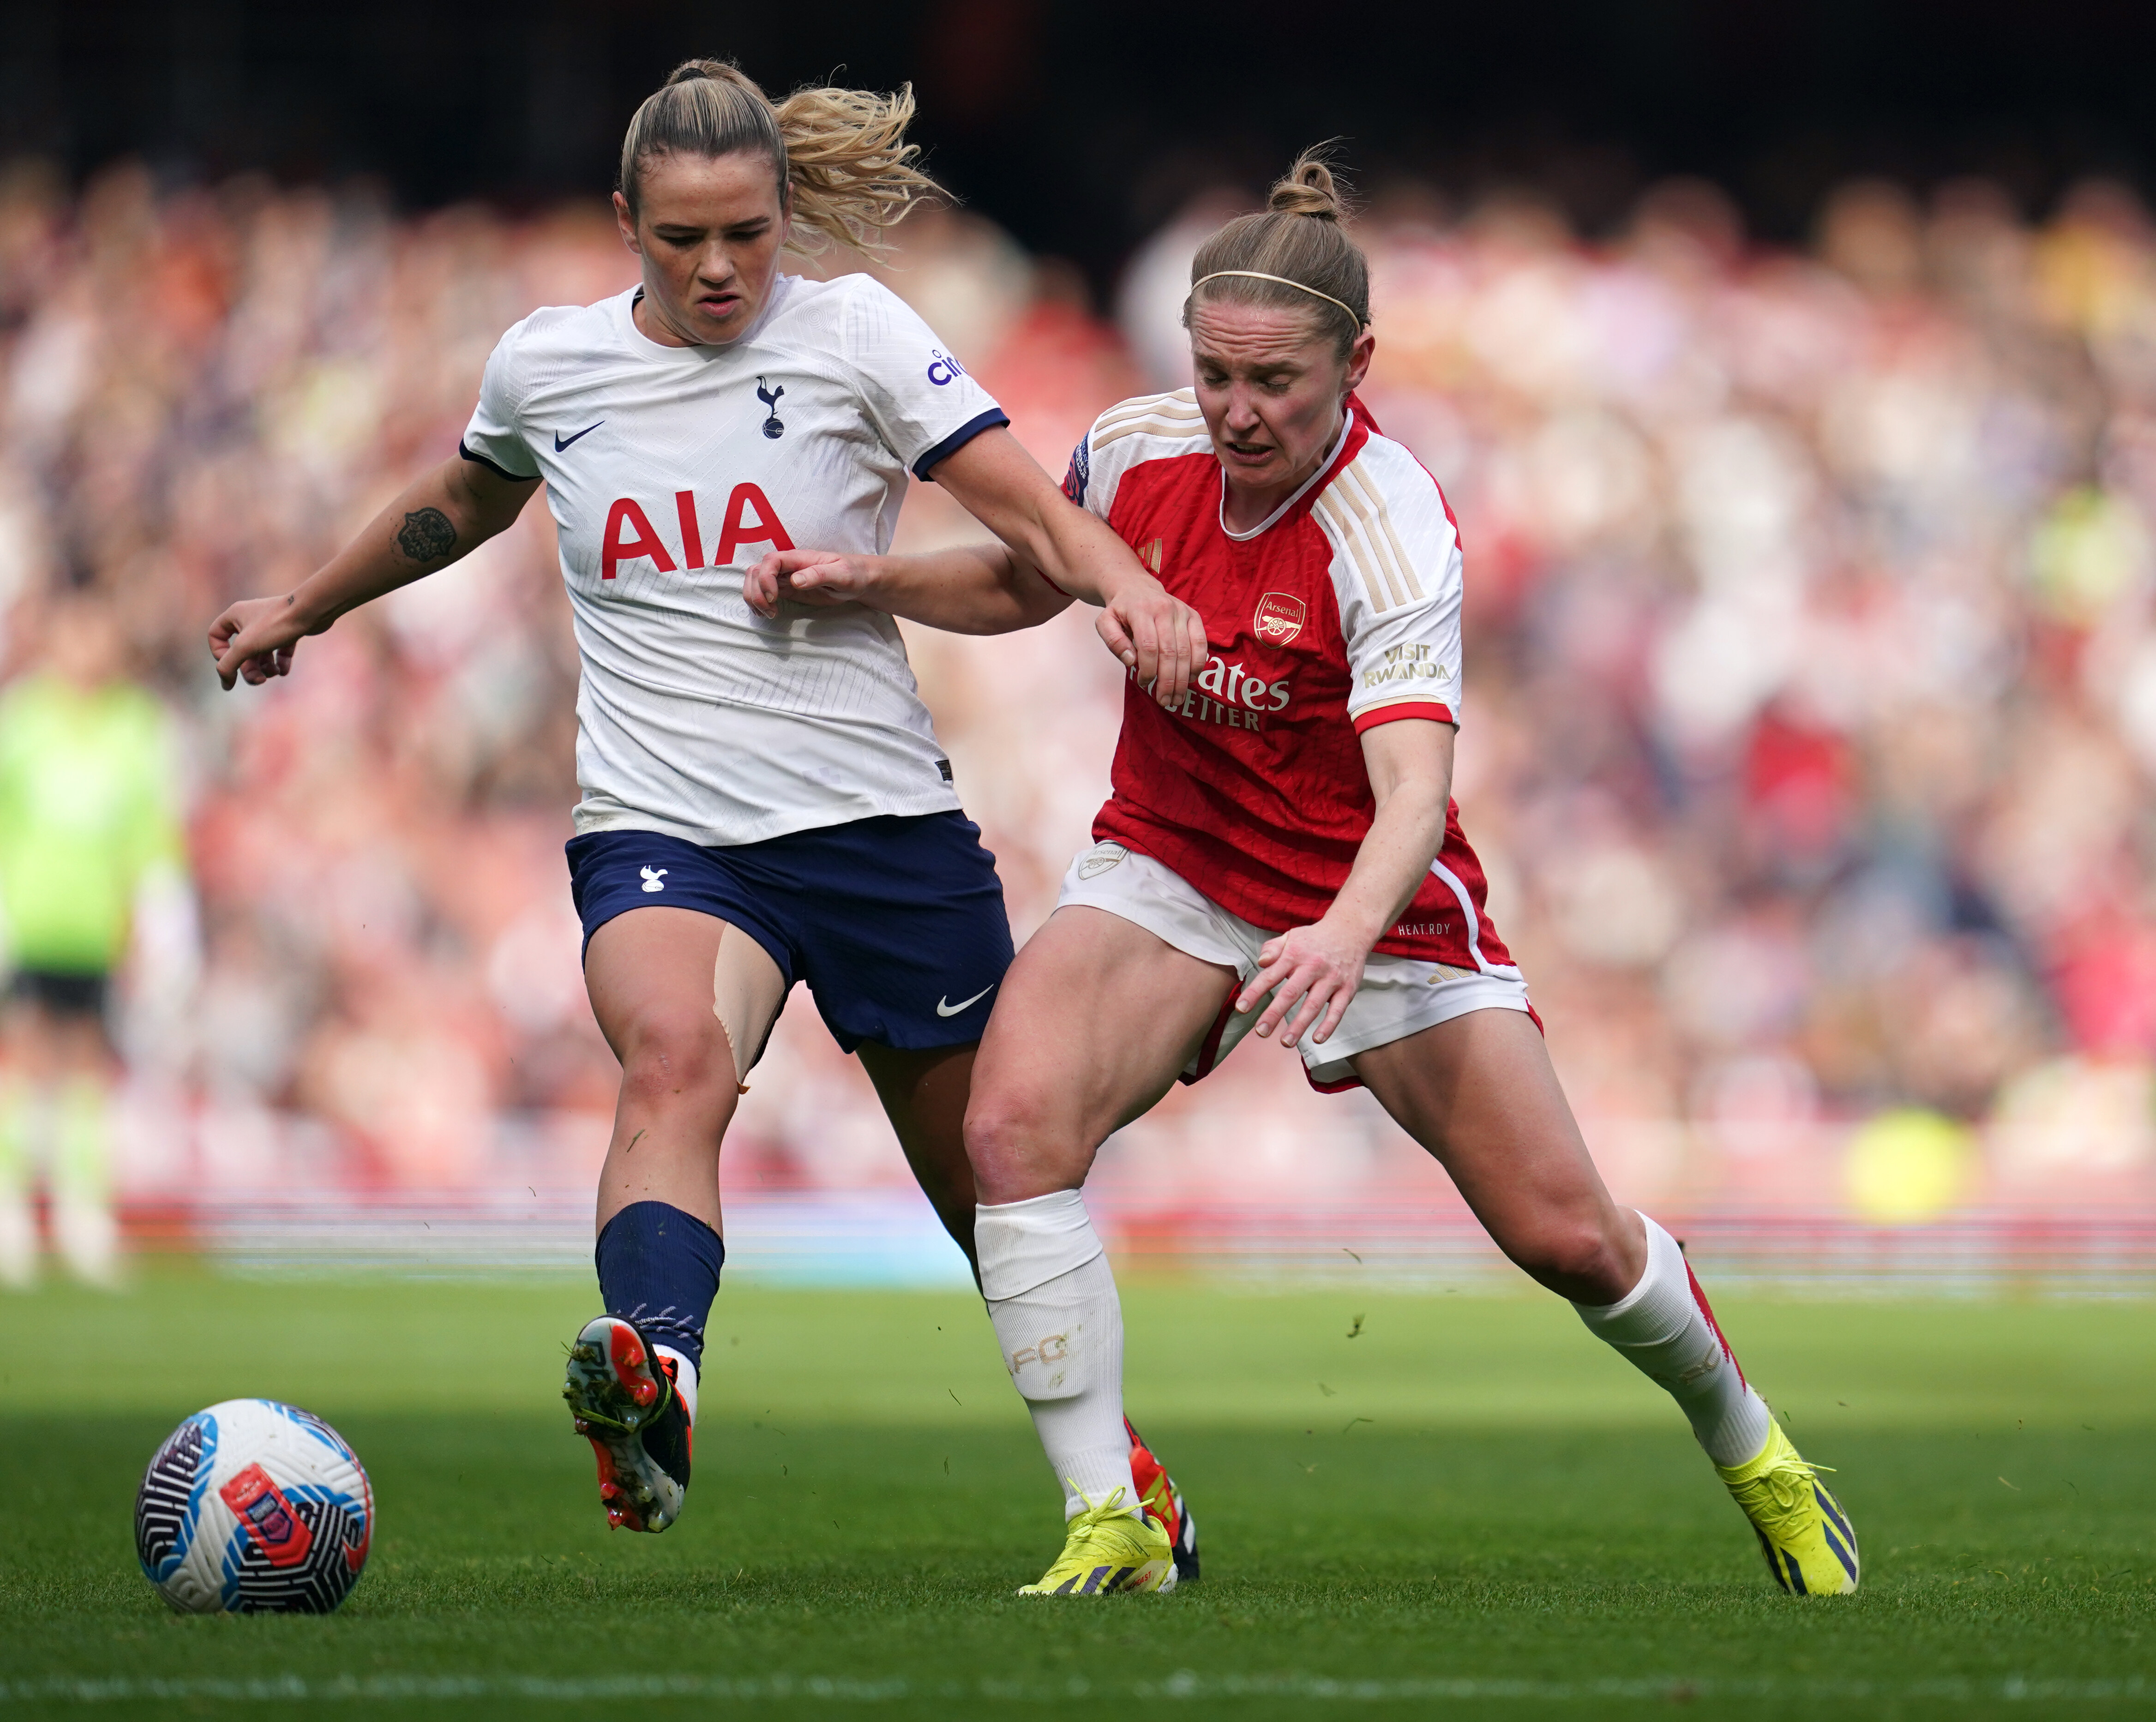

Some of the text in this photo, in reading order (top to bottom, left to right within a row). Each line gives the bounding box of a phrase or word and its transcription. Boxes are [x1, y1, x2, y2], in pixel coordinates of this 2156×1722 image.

[601, 482, 797, 580] AIA
[1265, 601, 1299, 618] Arsenal
[1385, 643, 1430, 665] VISIT
[1363, 662, 1451, 689] RWANDA
[1398, 923, 1450, 936] HEAT.RDY
